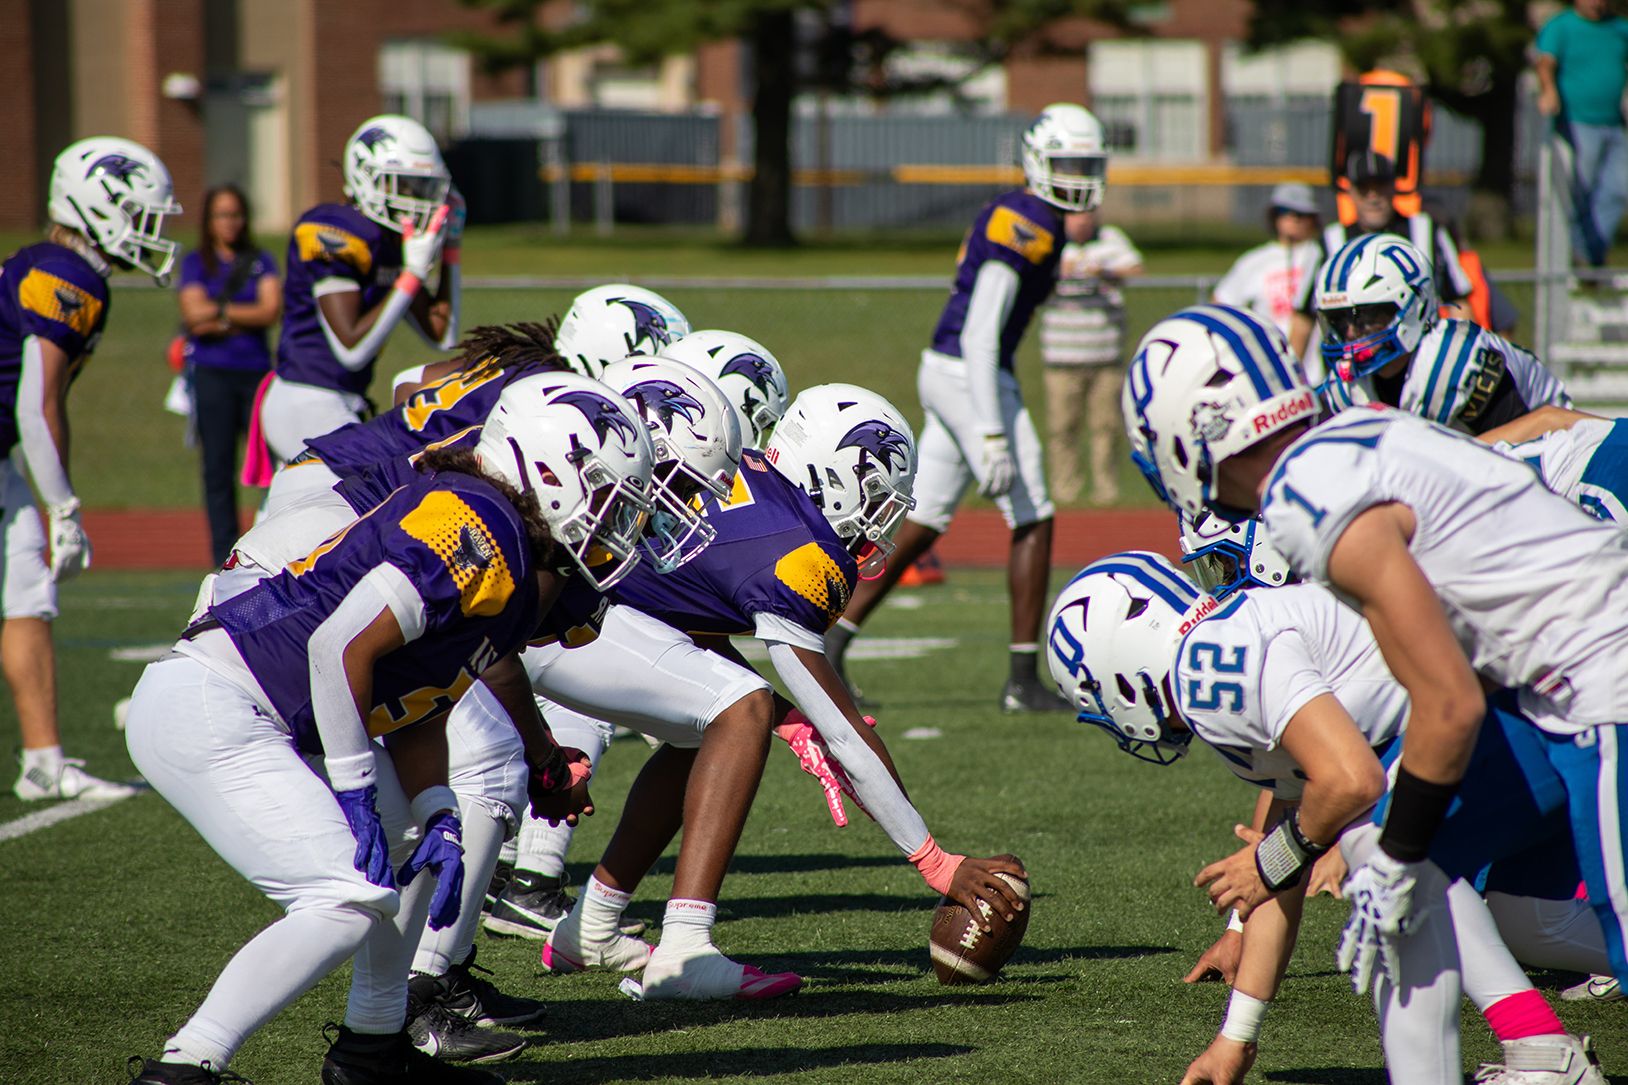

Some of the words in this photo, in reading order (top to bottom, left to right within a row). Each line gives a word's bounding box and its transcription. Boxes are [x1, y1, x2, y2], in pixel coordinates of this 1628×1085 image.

[1360, 88, 1400, 161] 1
[1253, 391, 1314, 433] Riddel
[1283, 482, 1327, 528] 1
[1188, 642, 1248, 714] 52
[667, 900, 707, 911] Supreme
